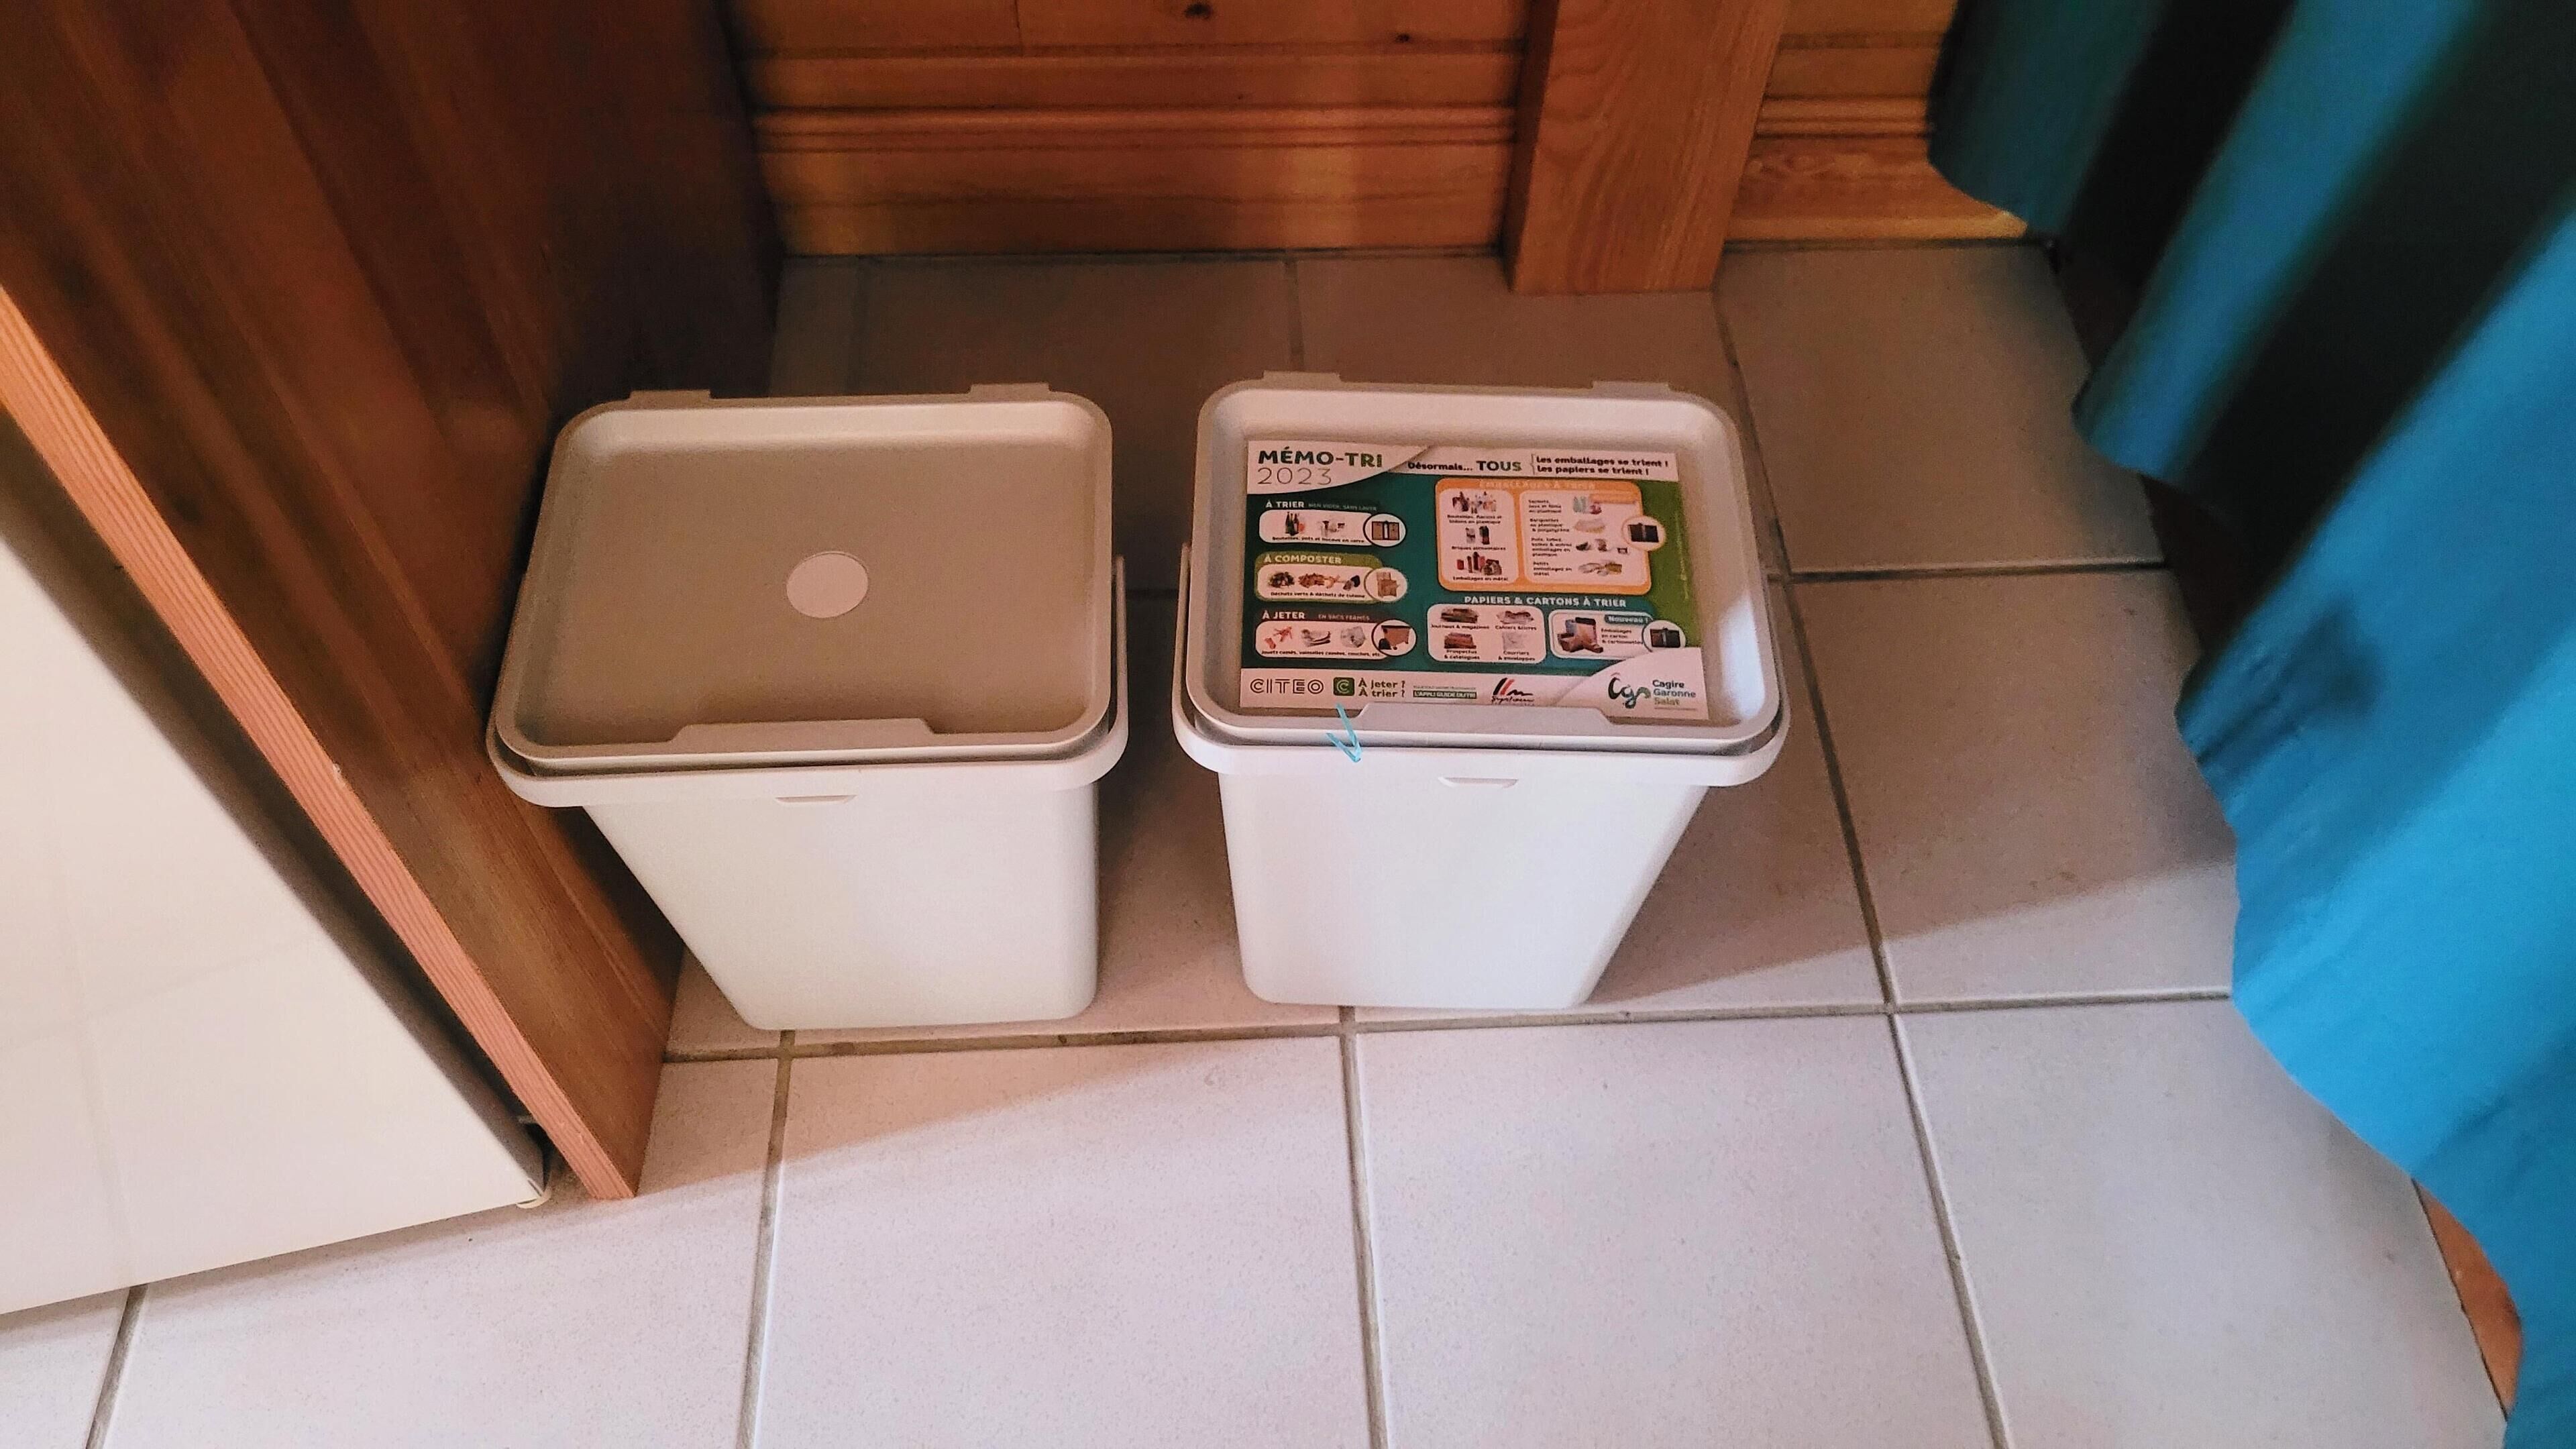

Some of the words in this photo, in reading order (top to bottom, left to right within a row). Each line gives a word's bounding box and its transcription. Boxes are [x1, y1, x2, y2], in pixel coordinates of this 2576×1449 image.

[1258, 447, 1383, 468] MÉMO-TRI
[1554, 457, 1615, 466] emballages
[1476, 460, 1522, 472] TOUS
[1555, 466, 1595, 474] papiers
[1257, 468, 1332, 485] 2023
[1264, 554, 1272, 563] À
[1275, 555, 1342, 564] COMPOSTER
[1464, 596, 1510, 604] PAPIERS
[1514, 596, 1522, 604] &
[1526, 597, 1580, 606] CARTONS
[1583, 596, 1591, 606] À
[1594, 599, 1627, 608] TRIER
[1262, 610, 1270, 619] À
[1250, 678, 1324, 694] CITEO
[1358, 677, 1367, 687] À
[1371, 680, 1398, 690] jeter
[1652, 680, 1684, 689] Cagire
[1358, 687, 1368, 697] À
[1371, 689, 1397, 698] trier
[1401, 690, 1405, 698] ?
[1653, 688, 1696, 698] Garonne
